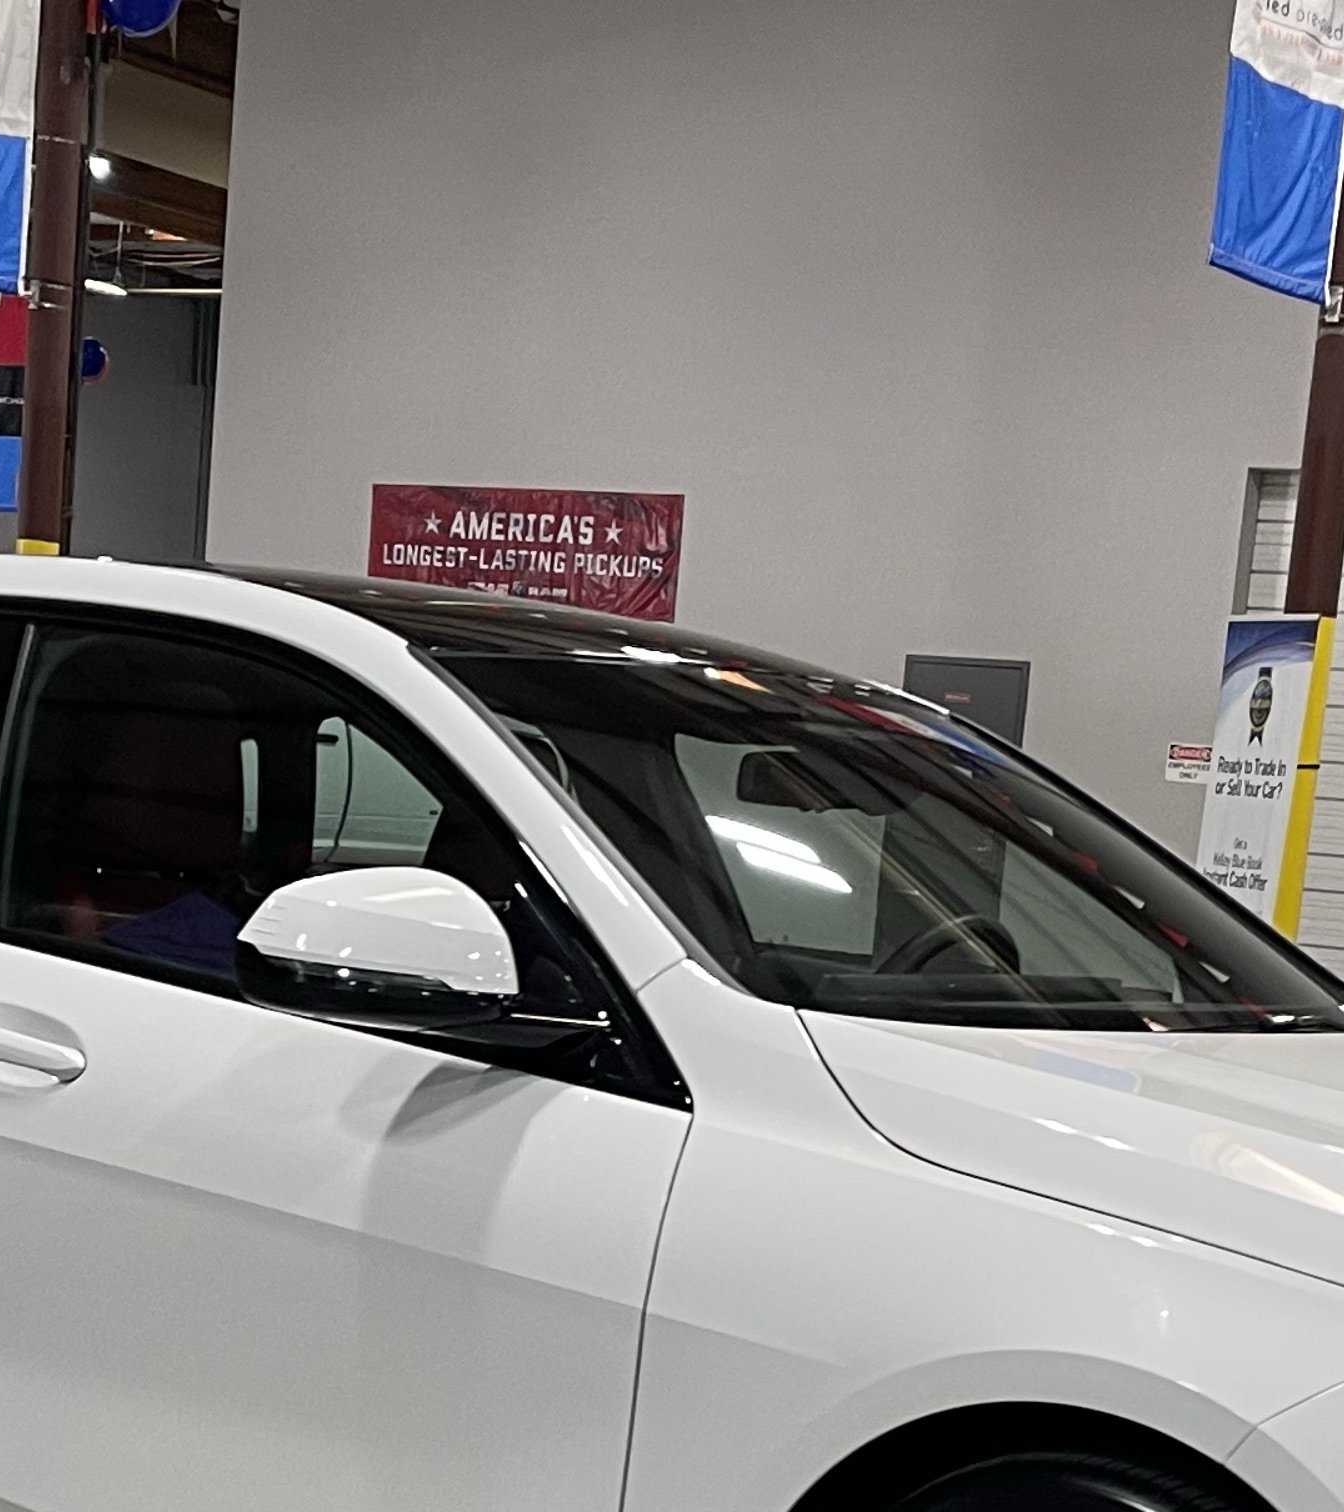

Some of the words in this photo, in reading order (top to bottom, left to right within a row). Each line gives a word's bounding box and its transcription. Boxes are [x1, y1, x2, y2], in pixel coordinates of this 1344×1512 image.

[449, 510, 595, 545] AMERICA'S
[383, 544, 566, 574] LONGEST-LASTING
[573, 552, 663, 579] PICKUPS
[1217, 756, 1243, 777] Ready
[1244, 760, 1253, 774] to
[1255, 758, 1276, 776] Trade
[1227, 778, 1243, 796] Sell
[1244, 780, 1261, 797] Your
[1262, 781, 1283, 799] Car?
